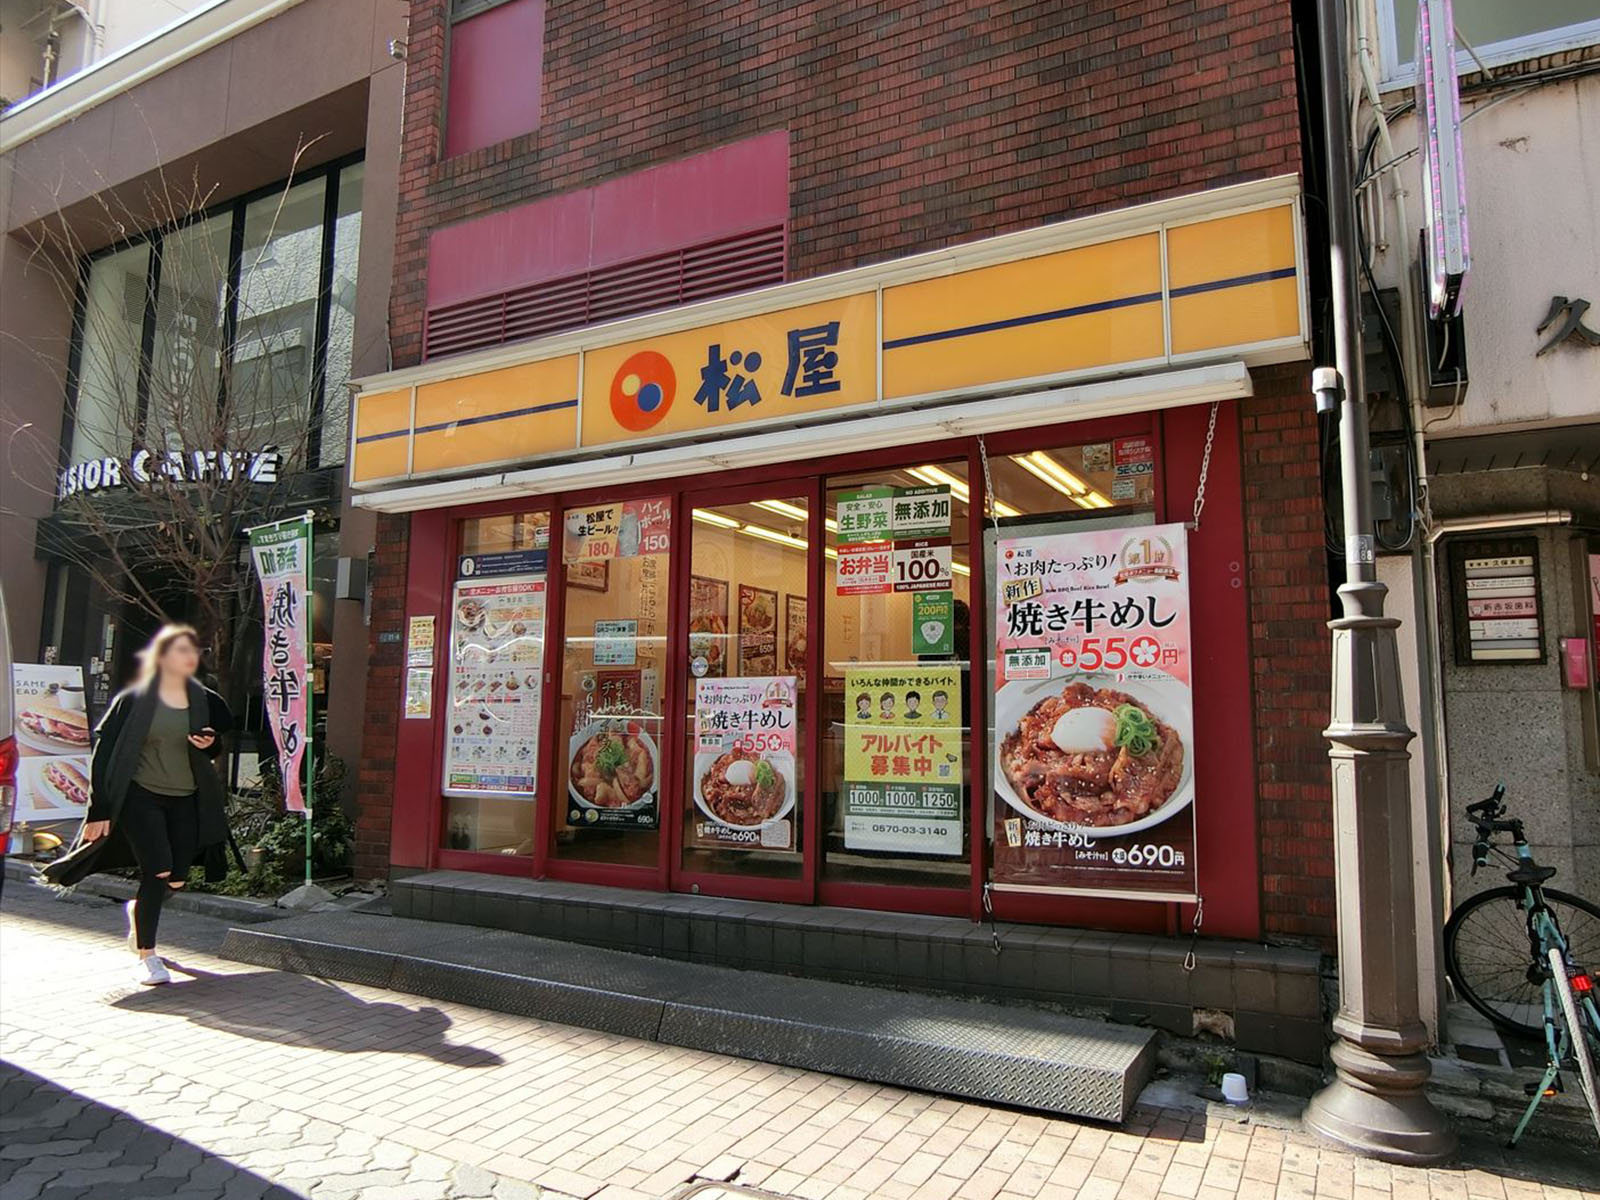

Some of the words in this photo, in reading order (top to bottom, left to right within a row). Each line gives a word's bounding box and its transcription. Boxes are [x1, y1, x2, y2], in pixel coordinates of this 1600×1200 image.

[693, 321, 841, 413] 松屋
[846, 500, 883, 512] 安全・安心
[894, 499, 949, 521] 無添加
[586, 508, 614, 524] 松屋で
[840, 511, 888, 531] 生野菜
[588, 542, 610, 558] 180
[643, 535, 669, 551] 150
[911, 549, 935, 559] 国産米
[839, 554, 889, 575] お弁当
[910, 582, 936, 590] JAPANESE
[1004, 579, 1039, 600] 新作
[1006, 595, 1178, 638] 焼き牛めし
[1008, 654, 1046, 667] 無添加
[711, 709, 791, 730] 焼き牛めし
[861, 734, 943, 754] アルバイト
[871, 755, 932, 777] 募集中
[850, 791, 879, 804] 1000
[887, 792, 916, 806] 1000
[924, 793, 954, 807] 1250
[872, 824, 948, 837] 0570-03-3140
[1024, 831, 1097, 848] 焼き牛めし
